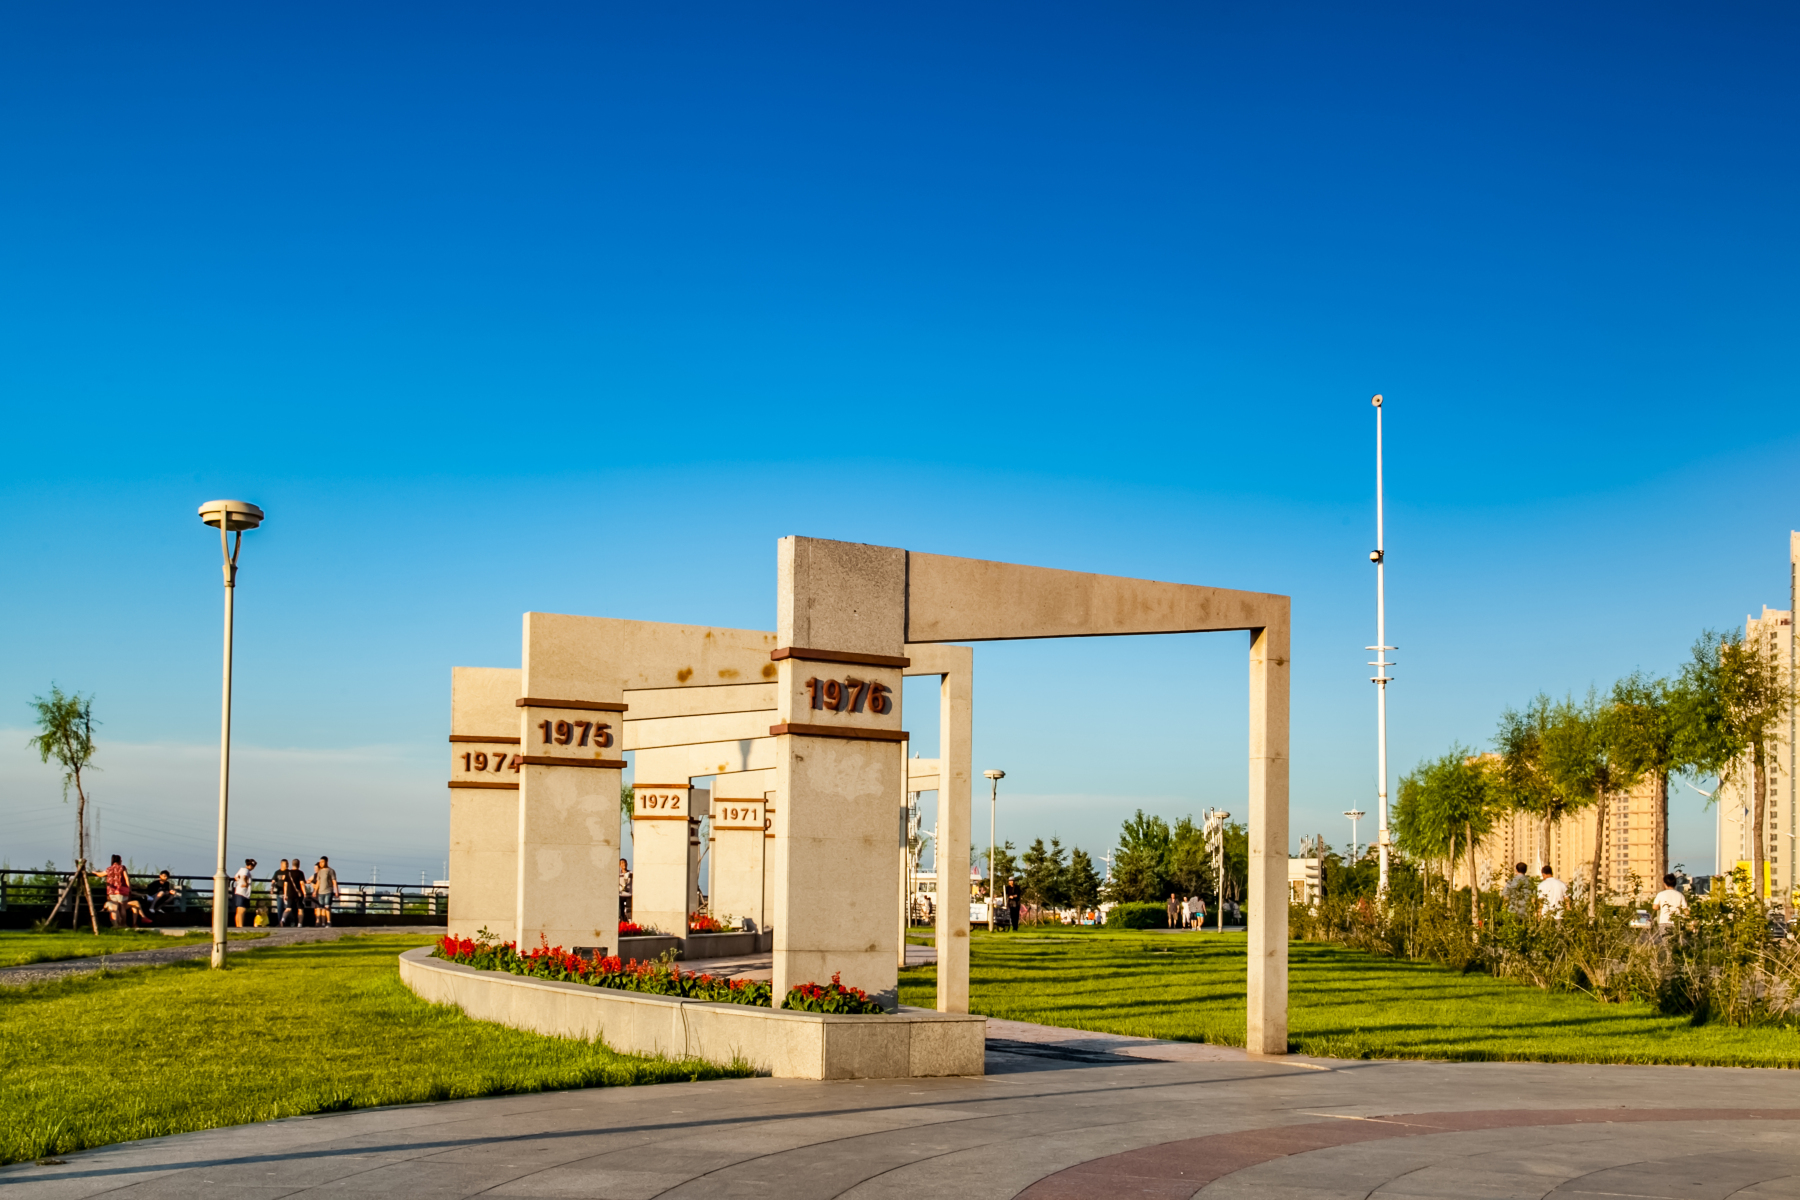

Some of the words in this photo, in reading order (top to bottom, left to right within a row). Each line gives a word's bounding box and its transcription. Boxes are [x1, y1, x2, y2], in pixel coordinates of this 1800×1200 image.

[805, 676, 886, 714] 1976
[538, 719, 609, 748] 1975
[461, 750, 521, 773] 1974
[640, 794, 680, 809] 1972
[722, 807, 757, 821] 1971
